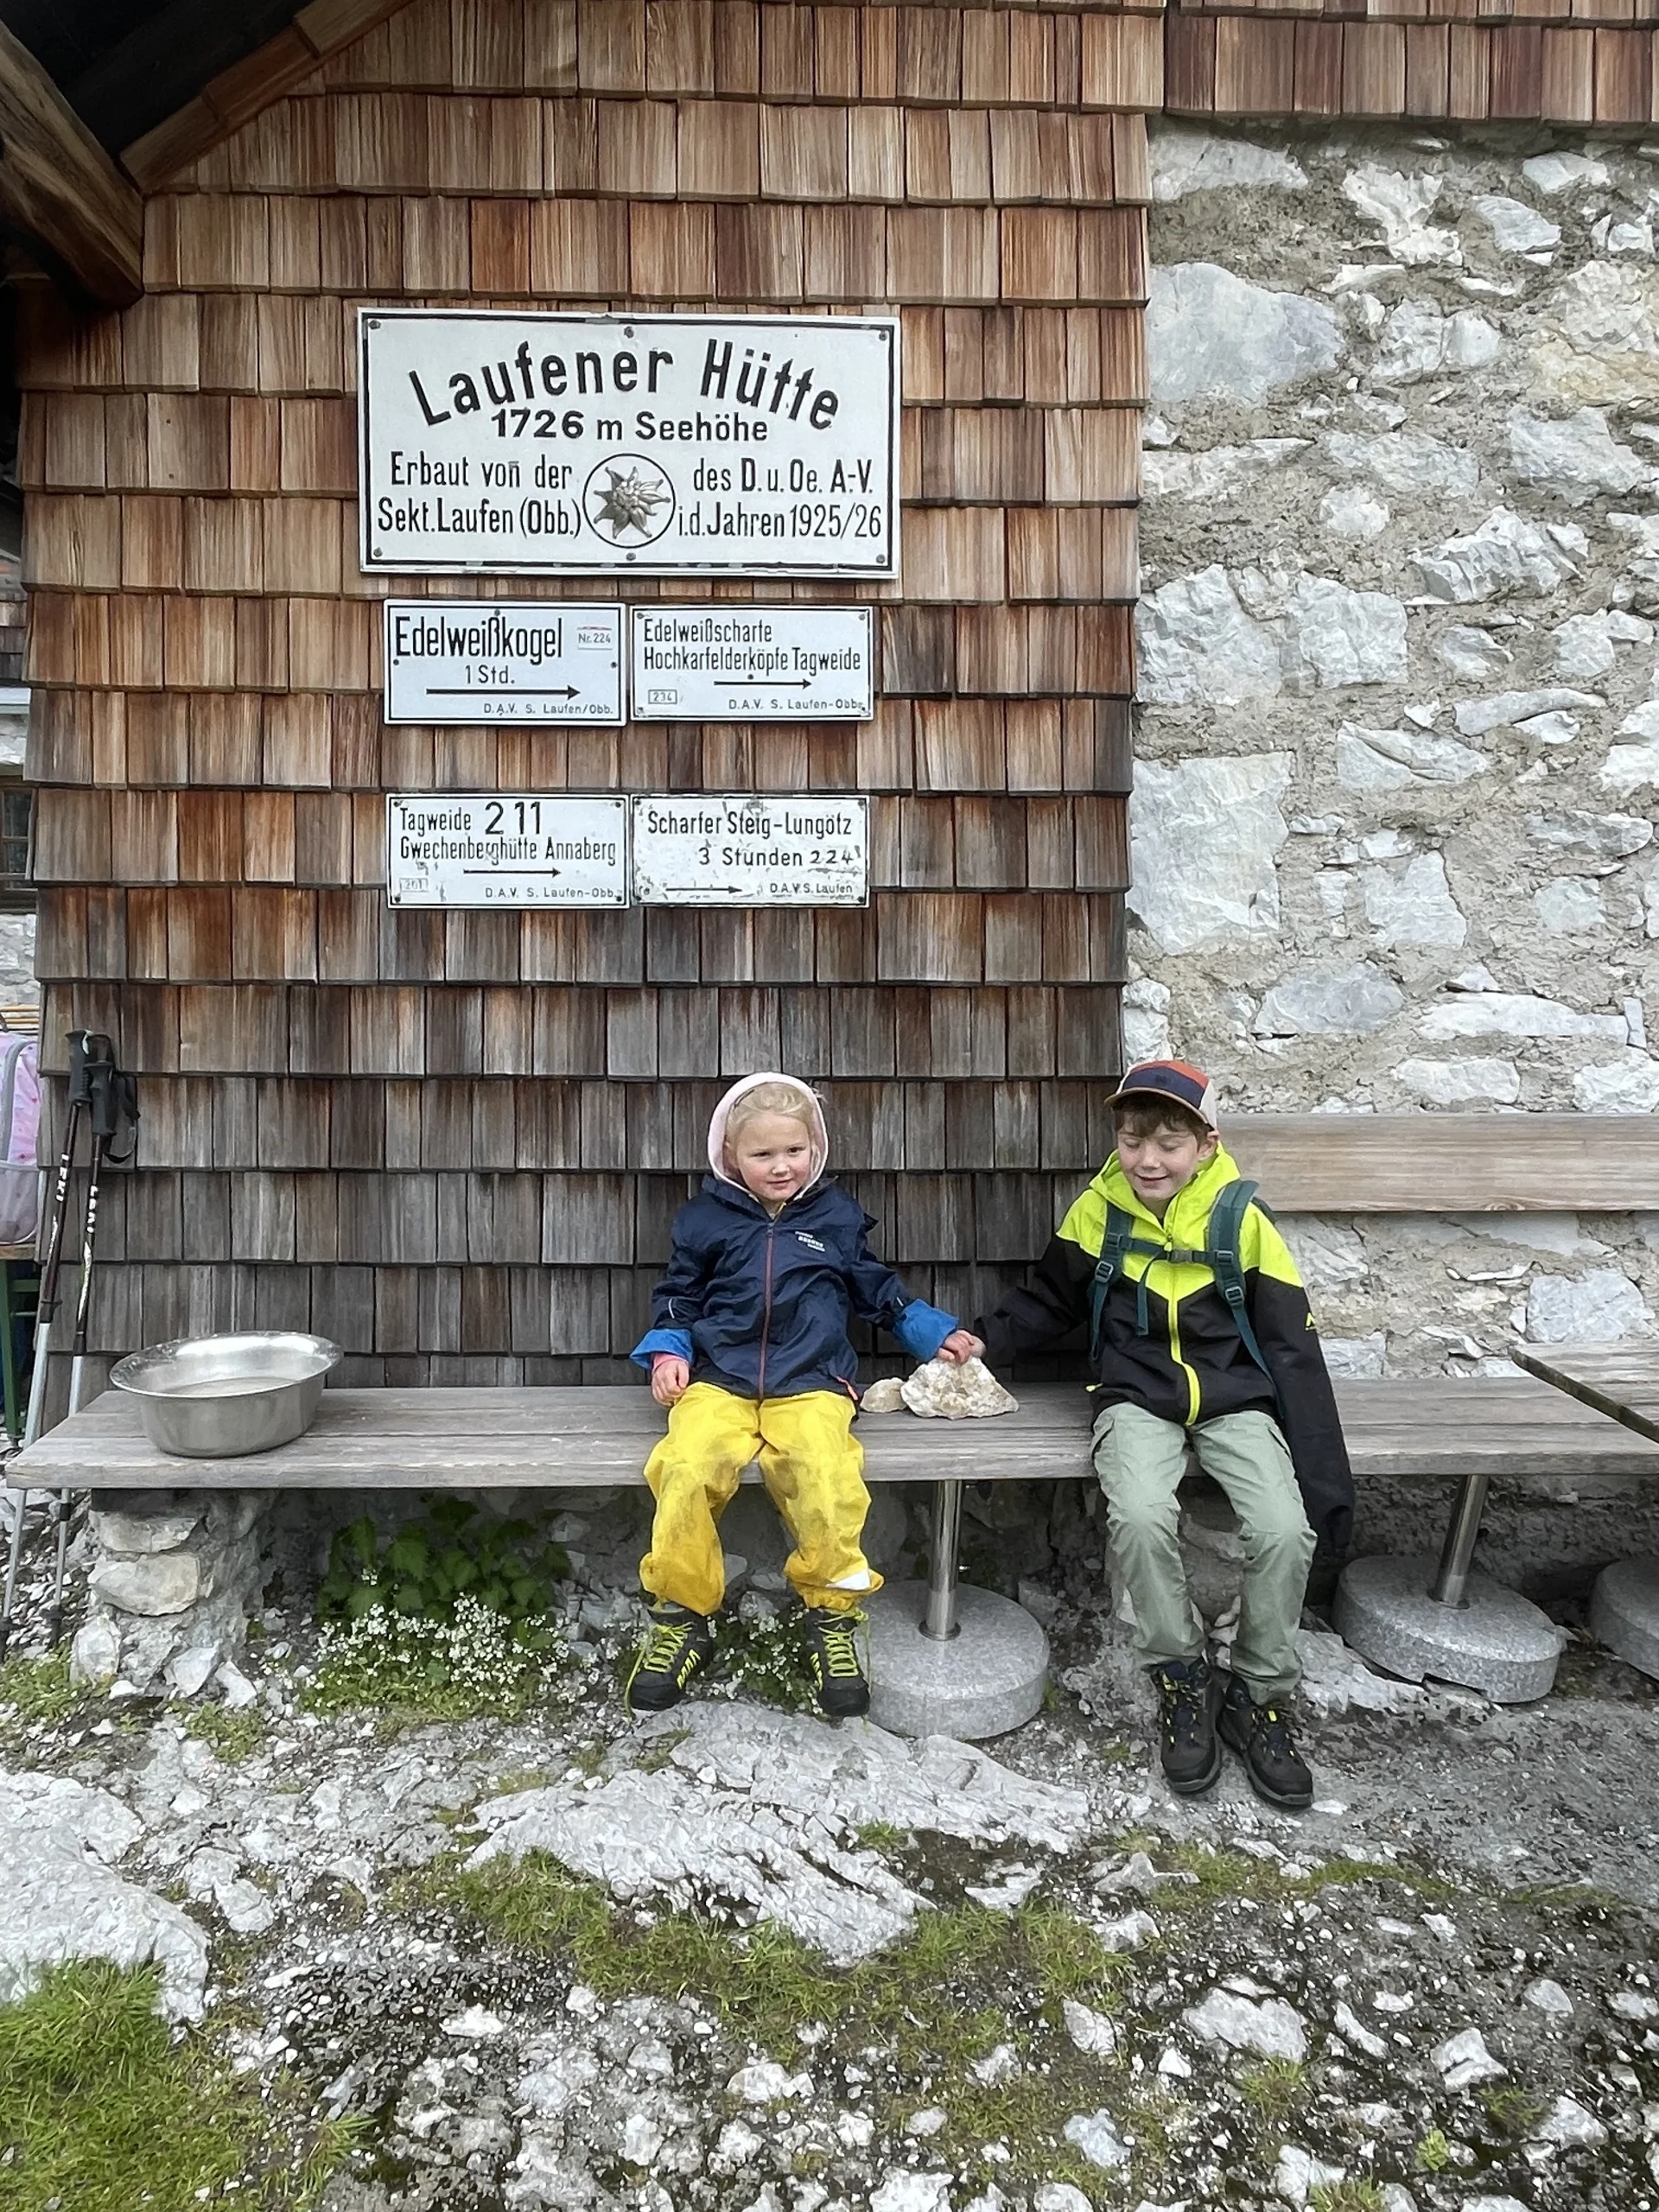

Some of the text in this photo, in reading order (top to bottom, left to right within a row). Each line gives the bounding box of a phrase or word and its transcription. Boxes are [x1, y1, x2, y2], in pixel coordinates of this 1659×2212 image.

[409, 339, 838, 429] Laufener Hütte
[492, 409, 768, 442] 1726 m Seehöhe
[391, 450, 469, 486] Erbaut
[534, 454, 573, 489] der
[693, 457, 731, 492] des
[519, 496, 582, 539] (Obb.)
[790, 502, 881, 539] 1925/26
[395, 616, 562, 665] Edelweißkogel
[644, 619, 772, 643] Edelweißscharte
[465, 664, 516, 684] 1 Std.
[644, 646, 861, 677] Hochkarfelderköpfe Tagweide
[400, 801, 541, 836] Tagweide 211
[648, 810, 721, 835] Scharfer
[400, 836, 616, 866] Gwechenberghütte Annaberg
[698, 848, 854, 866] 3 Stunden 224
[817, 882, 853, 894] Laufen
